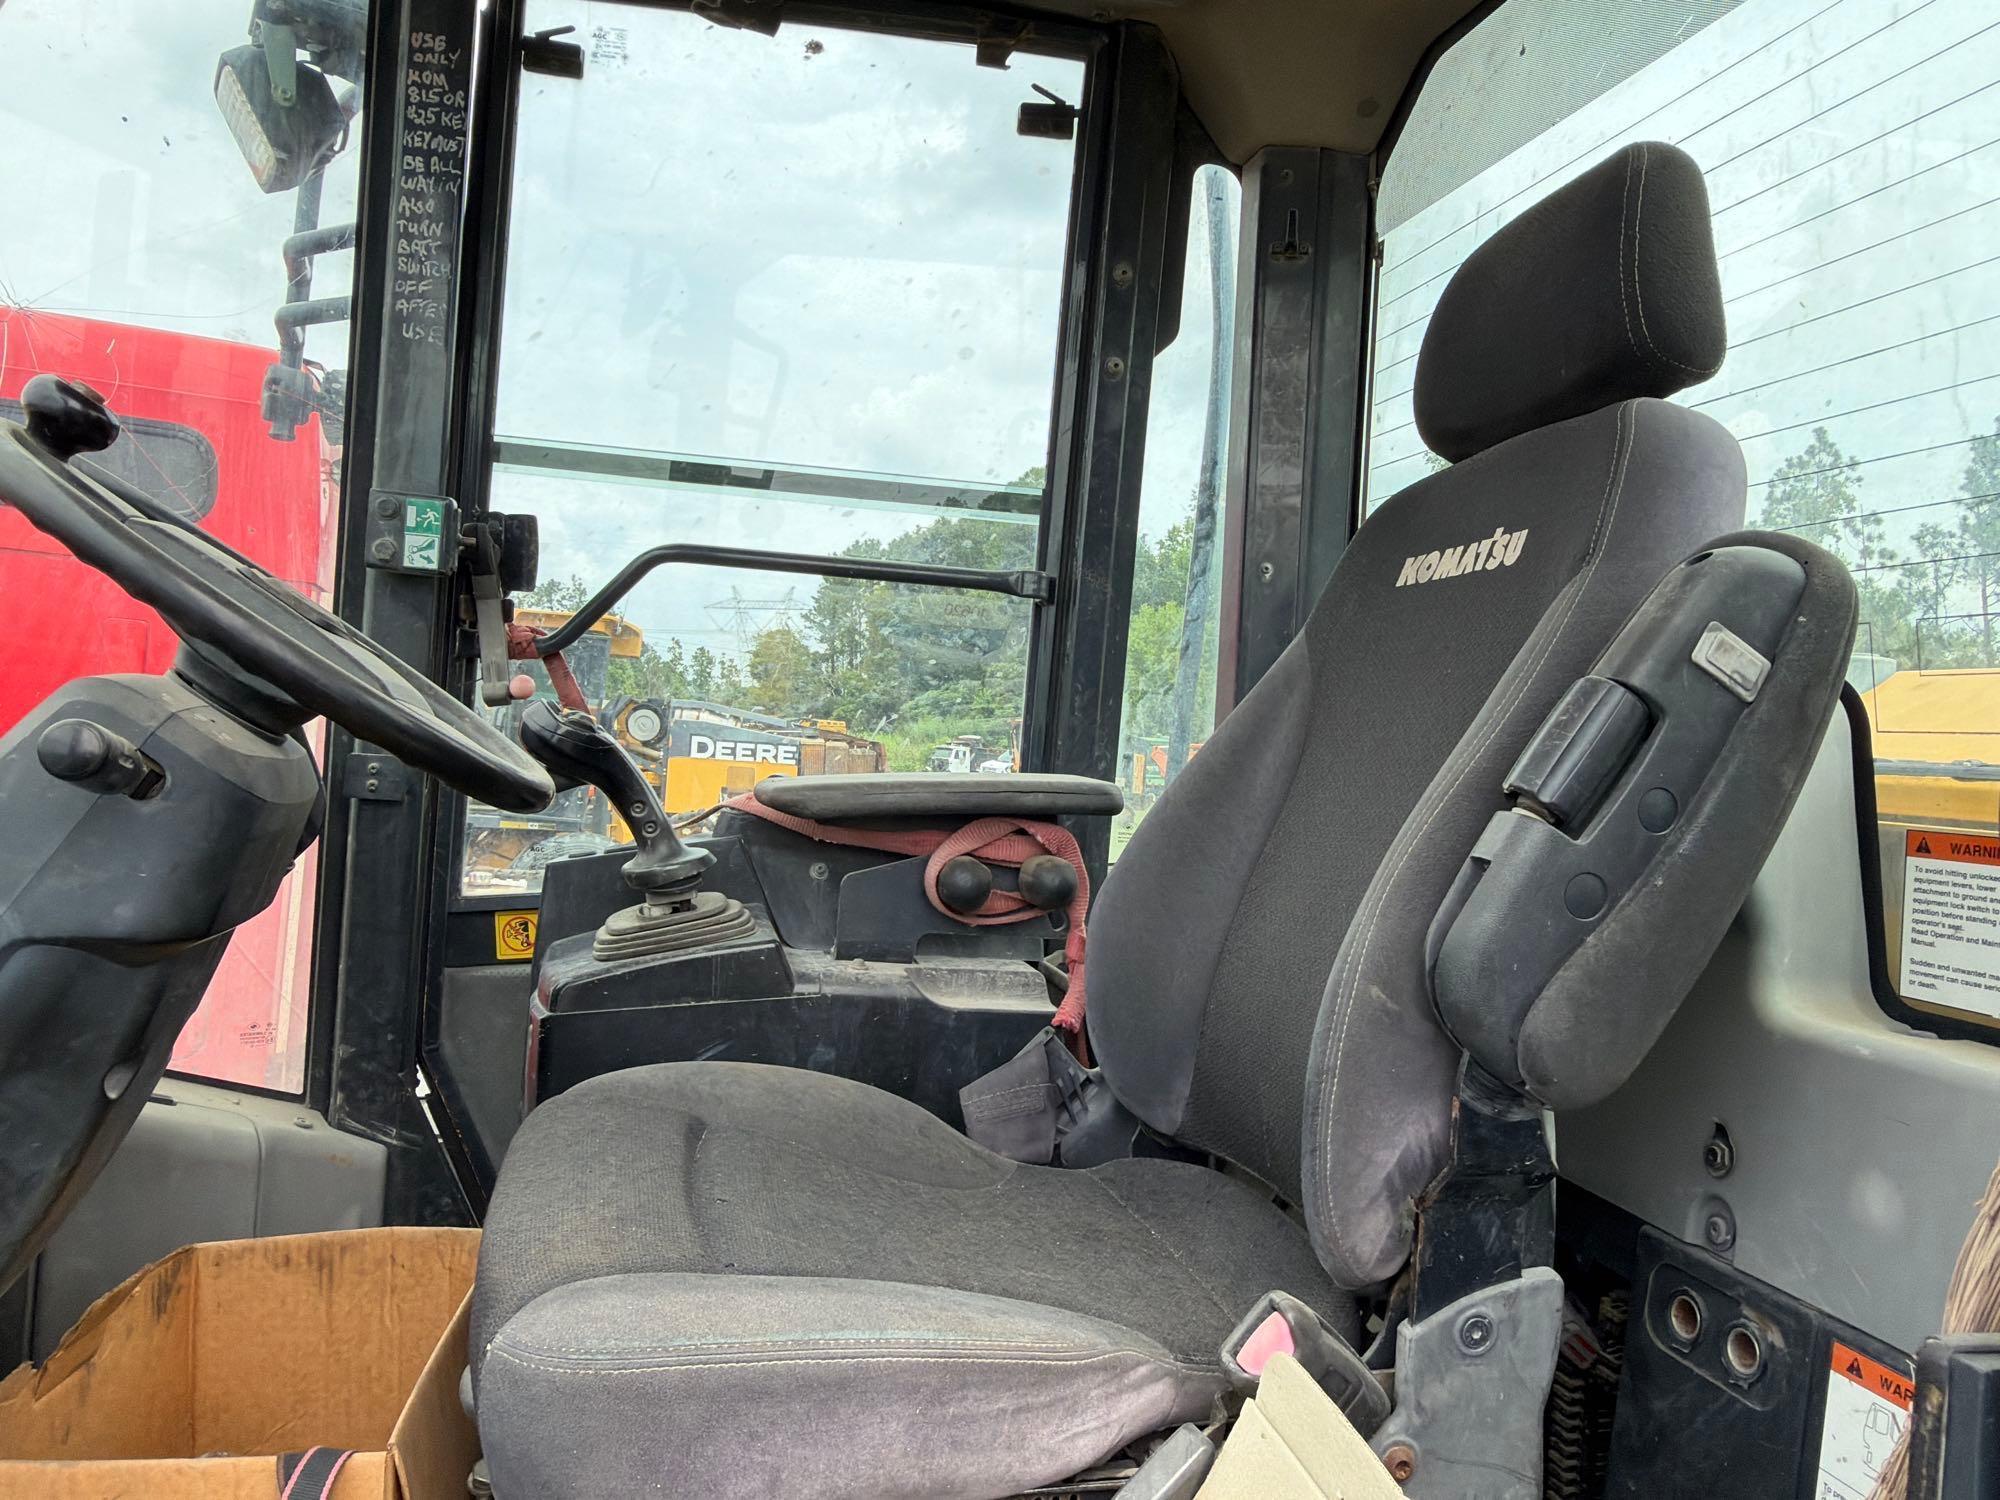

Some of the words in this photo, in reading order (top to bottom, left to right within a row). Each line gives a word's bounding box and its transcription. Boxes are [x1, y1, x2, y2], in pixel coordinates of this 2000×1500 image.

[413, 48, 461, 69] ONLY
[407, 86, 443, 104] 815
[443, 90, 465, 108] OR
[403, 130, 432, 150] KEY
[403, 155, 425, 173] BE
[430, 156, 462, 175] ALL
[400, 174, 435, 194] WAY
[399, 196, 435, 217] ALSO
[396, 220, 444, 237] TURN
[395, 279, 433, 295] OFF
[1395, 527, 1529, 587] KOMATSU
[690, 735, 797, 765] DEERE
[1925, 868, 1943, 876] avoid
[1945, 869, 1968, 880] hitting
[1913, 887, 1951, 897] attachment
[1961, 893, 1988, 902] ground
[1914, 877, 1950, 887] equipment
[1976, 884, 1997, 892] lower
[1912, 897, 1949, 908] equipment
[1950, 902, 1965, 911] lock
[1966, 905, 1991, 914] switch
[1912, 908, 1940, 918] position
[1941, 911, 1964, 921] before
[1965, 915, 1997, 928] standing
[1911, 926, 1929, 936] Read
[1930, 930, 1965, 942] Operation
[1965, 936, 1980, 945] and
[1909, 957, 1936, 969] Sudden
[1937, 964, 1951, 972] and
[1951, 966, 1987, 979] unwanted
[1909, 969, 1945, 981] movement
[1946, 976, 1959, 984] can
[1960, 979, 1983, 989] cause
